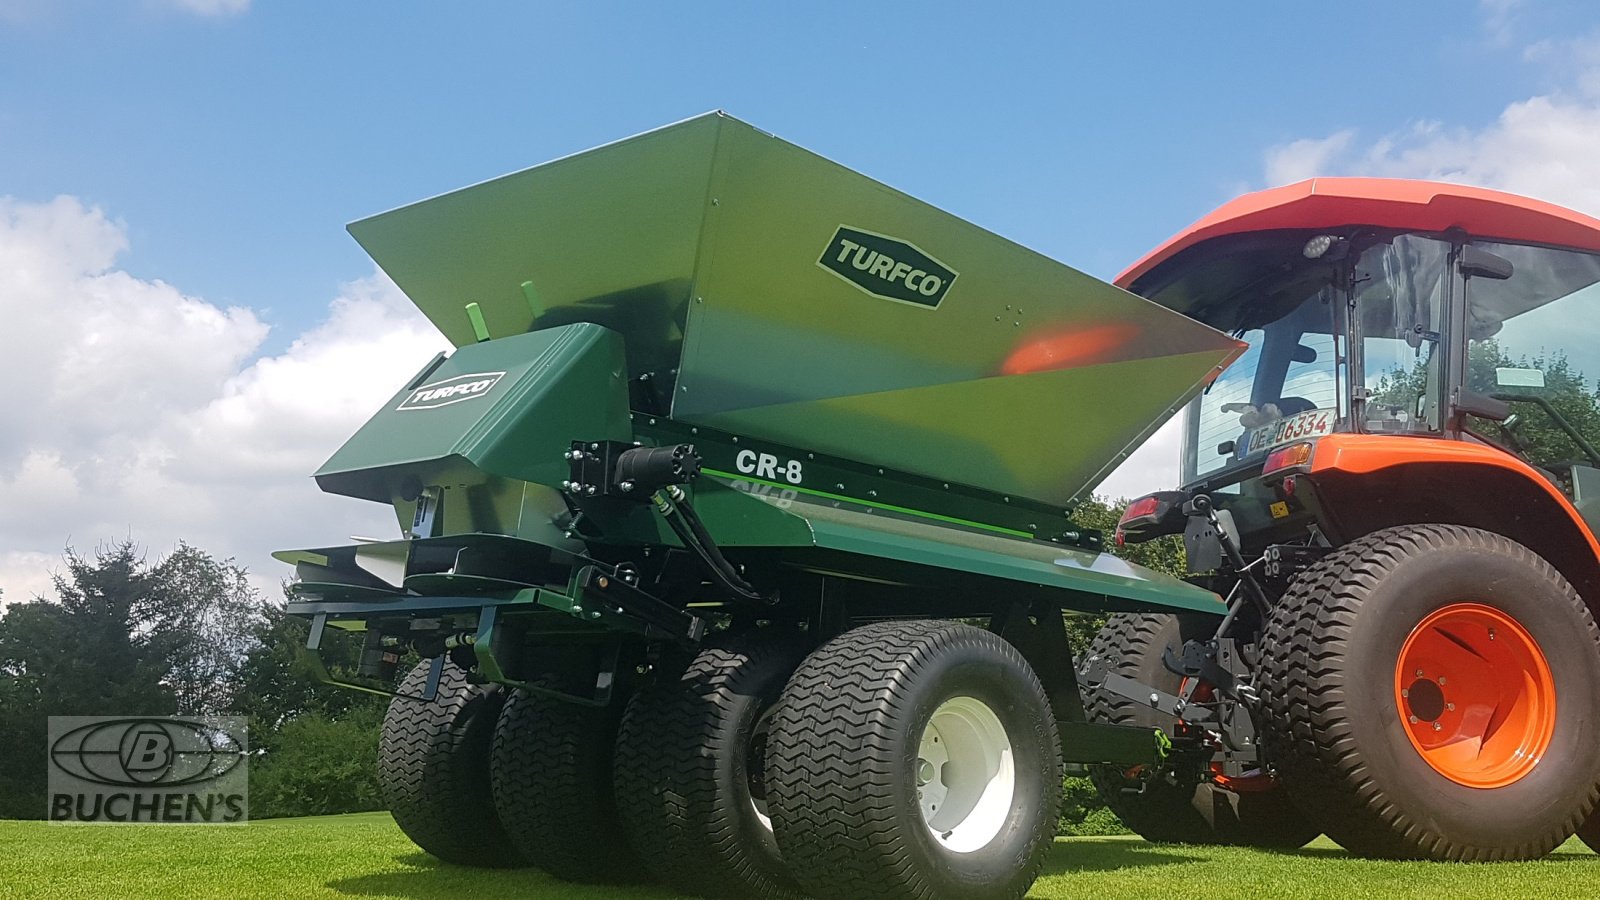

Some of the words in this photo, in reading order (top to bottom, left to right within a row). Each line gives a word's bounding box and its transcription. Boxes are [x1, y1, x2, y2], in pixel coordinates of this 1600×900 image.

[837, 238, 942, 297] TURFCO
[411, 380, 492, 404] TURFCO
[1249, 427, 1269, 452] OE
[1275, 411, 1330, 444] 06334
[735, 449, 803, 485] CR-8
